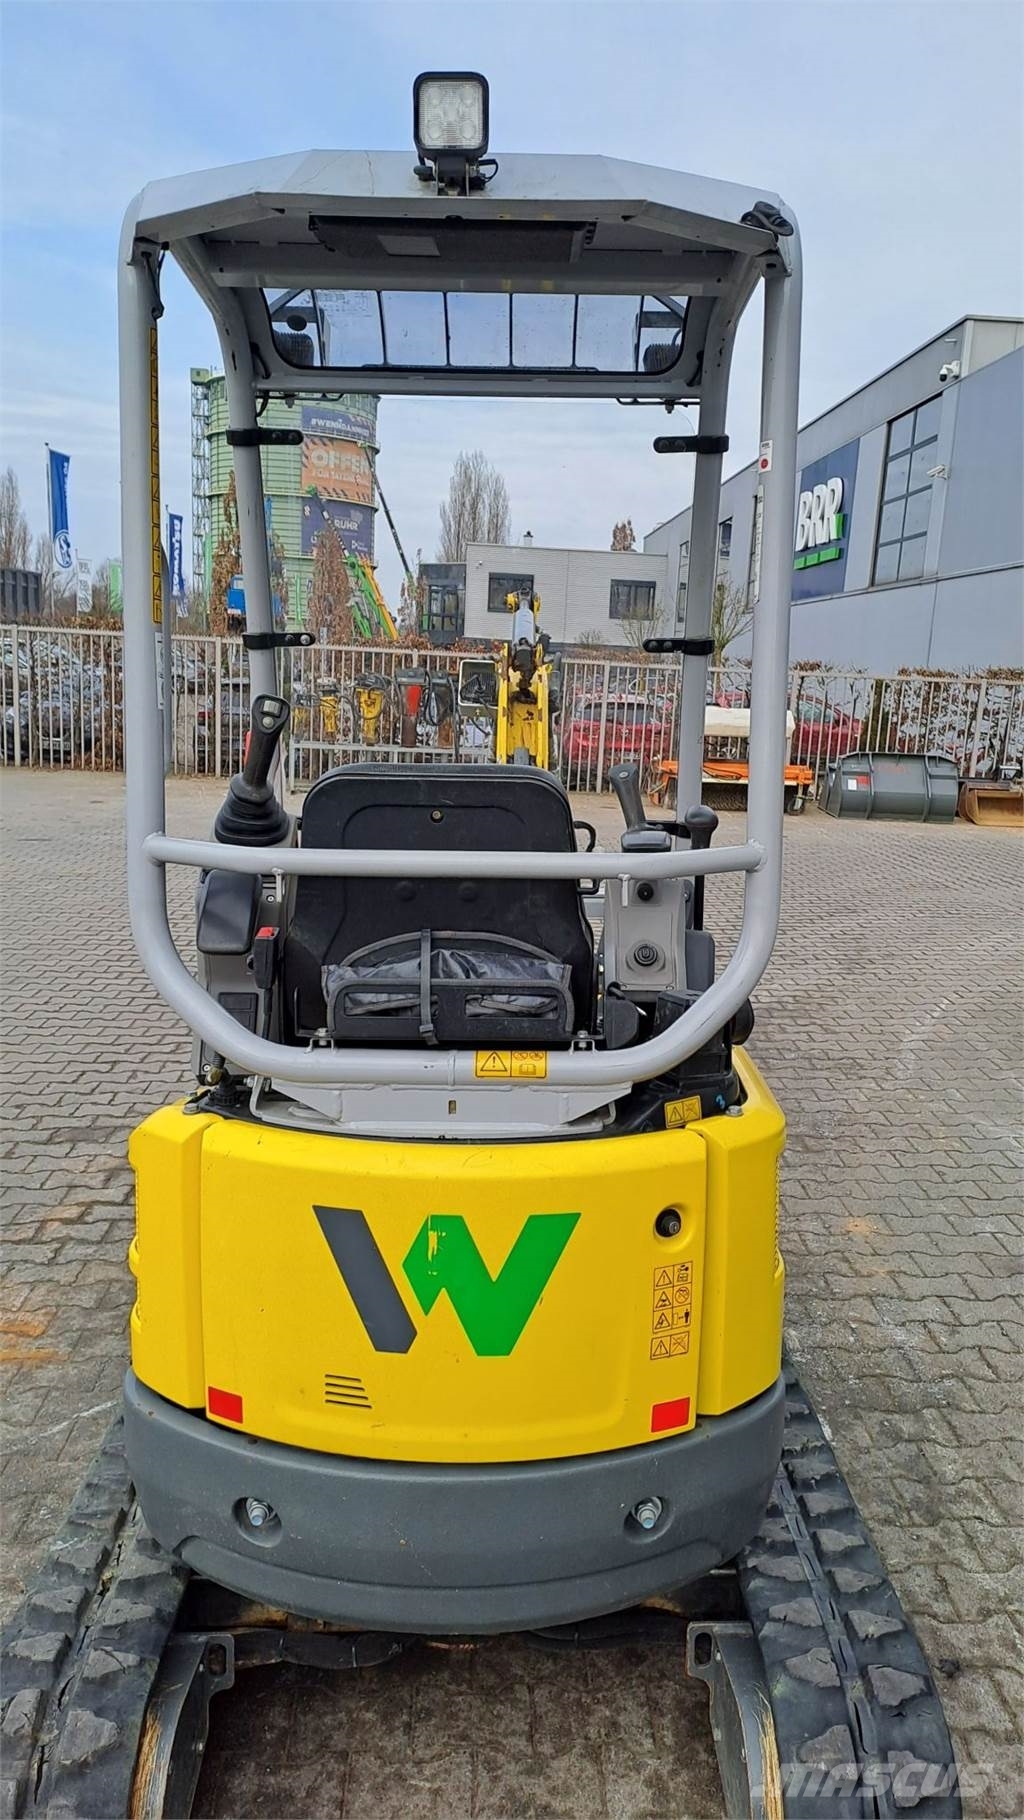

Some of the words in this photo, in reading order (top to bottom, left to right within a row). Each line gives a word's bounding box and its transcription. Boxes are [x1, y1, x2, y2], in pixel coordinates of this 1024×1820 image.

[334, 519, 358, 530] RUHR
[795, 477, 844, 551] BRR
[172, 519, 181, 596] KOMATSU
